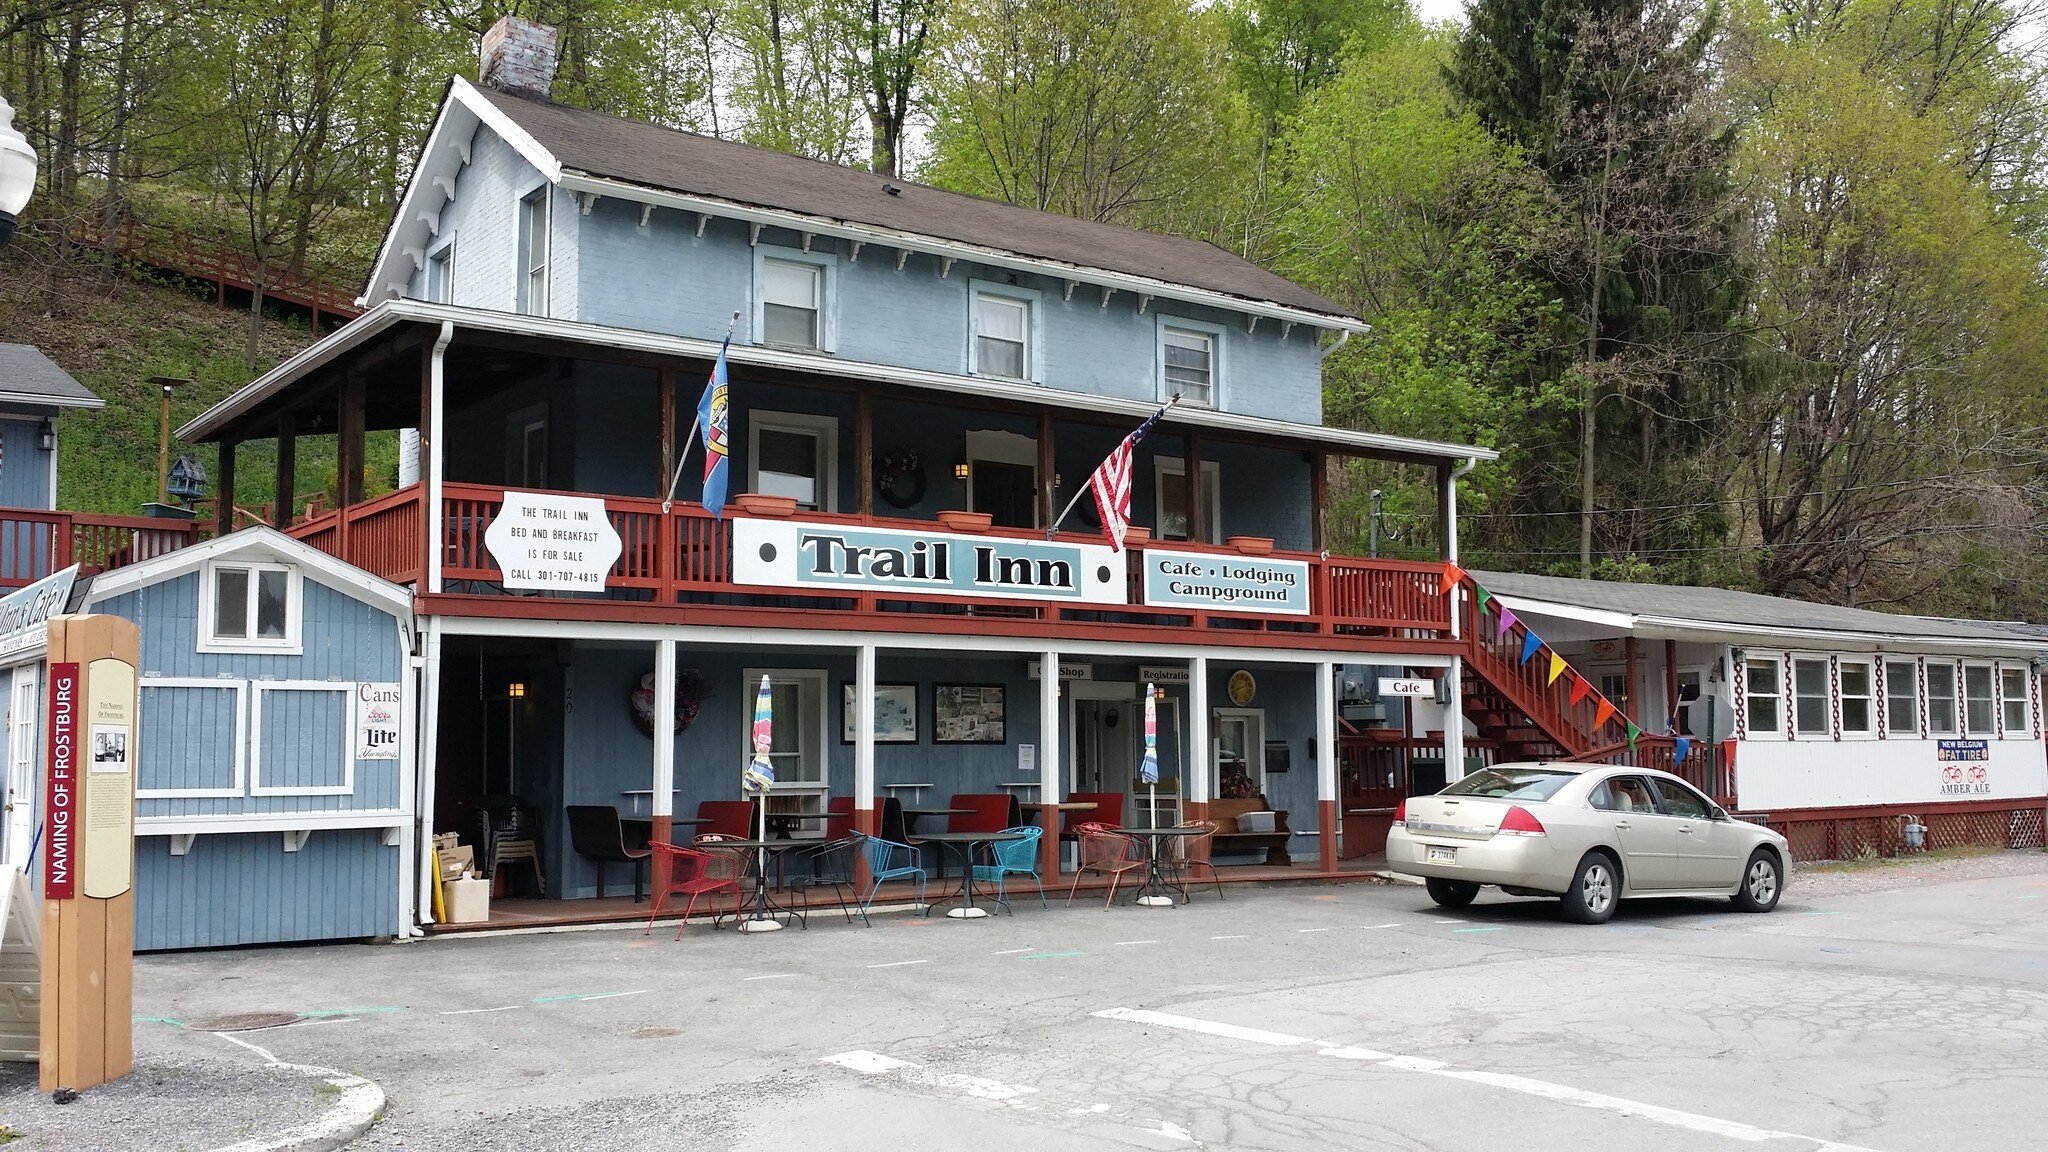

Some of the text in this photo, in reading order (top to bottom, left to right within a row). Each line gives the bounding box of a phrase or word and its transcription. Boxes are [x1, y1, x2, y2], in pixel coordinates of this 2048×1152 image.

[521, 507, 588, 521] THE TRAIL INN
[511, 527, 598, 542] BED AND BREAKFAST
[528, 549, 583, 561] IS FOR SALE
[801, 534, 1075, 590] Trail Inn
[511, 569, 598, 582] CALL 301-707-4815
[1159, 561, 1295, 585] Cafe Lodging
[1169, 581, 1287, 601] Campground
[1059, 667, 1084, 679] Shop
[1143, 670, 1189, 681] Registratio
[360, 684, 399, 702] Cans
[1393, 682, 1420, 693] Cafe
[367, 728, 396, 747] Lite
[1945, 749, 1981, 760] FAT TIRE
[52, 677, 72, 883] NAMING OF FROSTBURG
[1940, 783, 1990, 794] AMBER ALE
